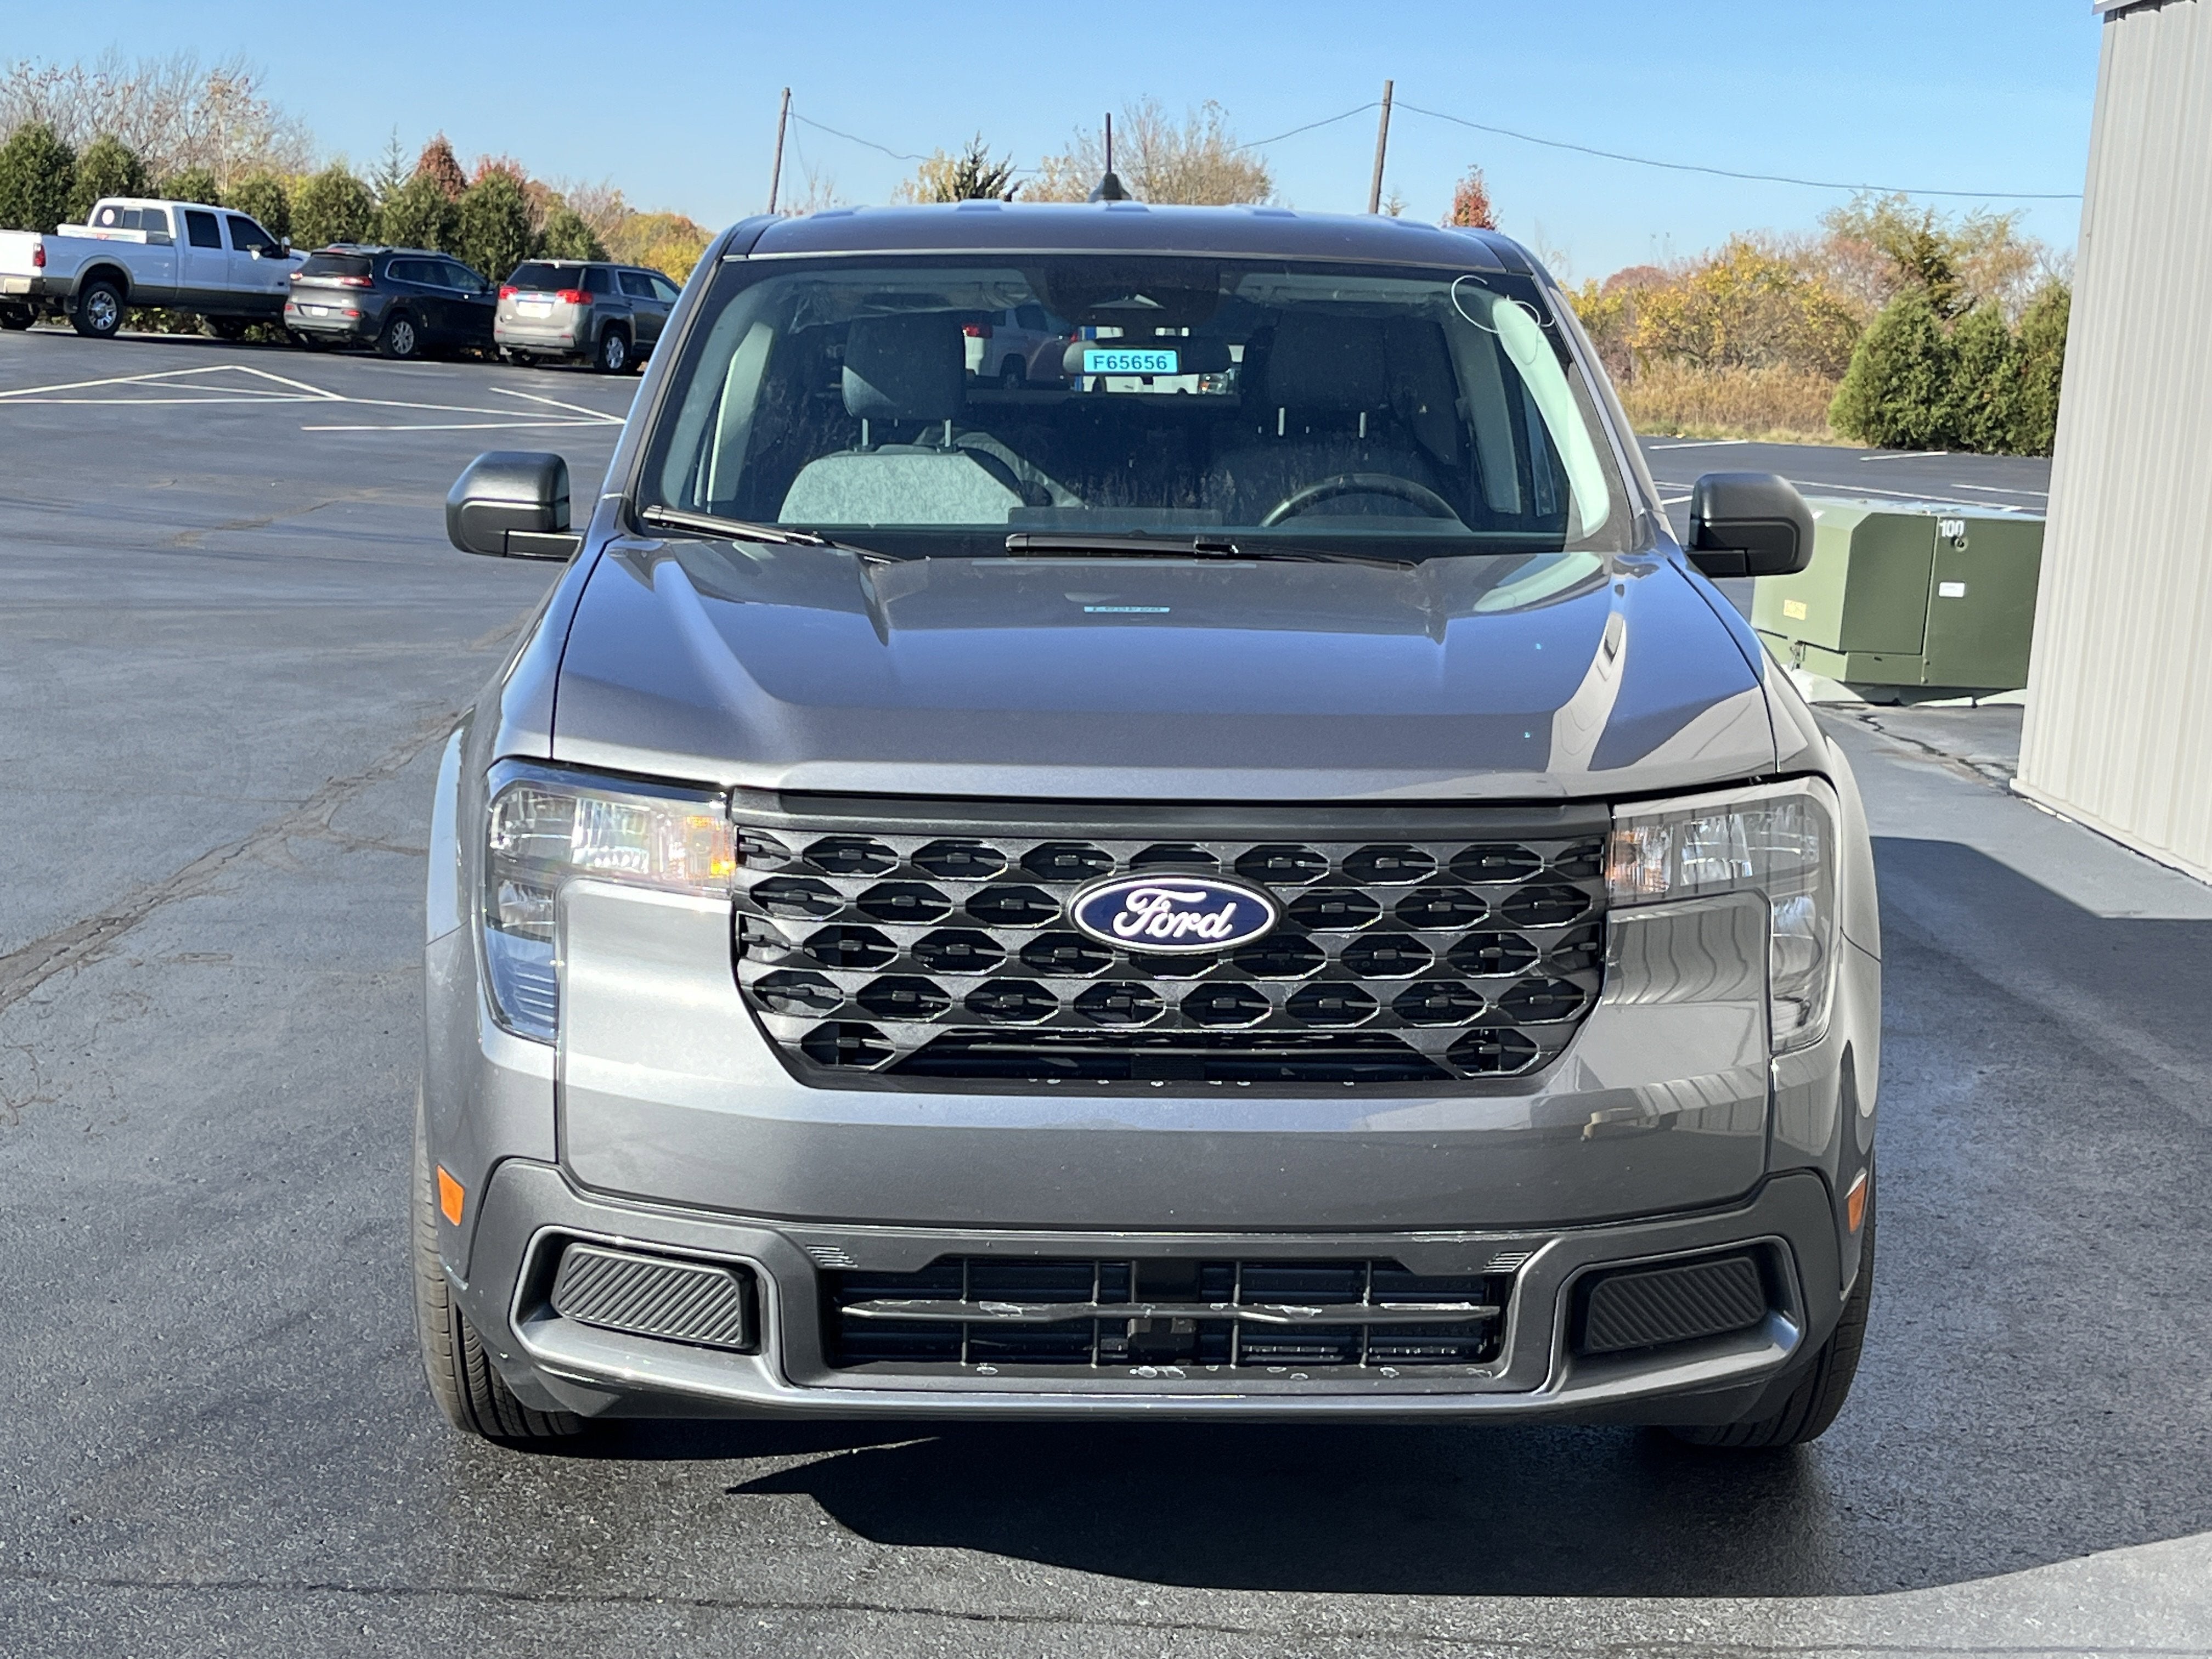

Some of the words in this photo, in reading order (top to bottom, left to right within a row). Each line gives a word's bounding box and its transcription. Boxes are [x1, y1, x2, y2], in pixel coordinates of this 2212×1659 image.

[1093, 355, 1167, 370] F65656
[1939, 519, 1965, 537] 100
[1113, 888, 1237, 938] Ford
